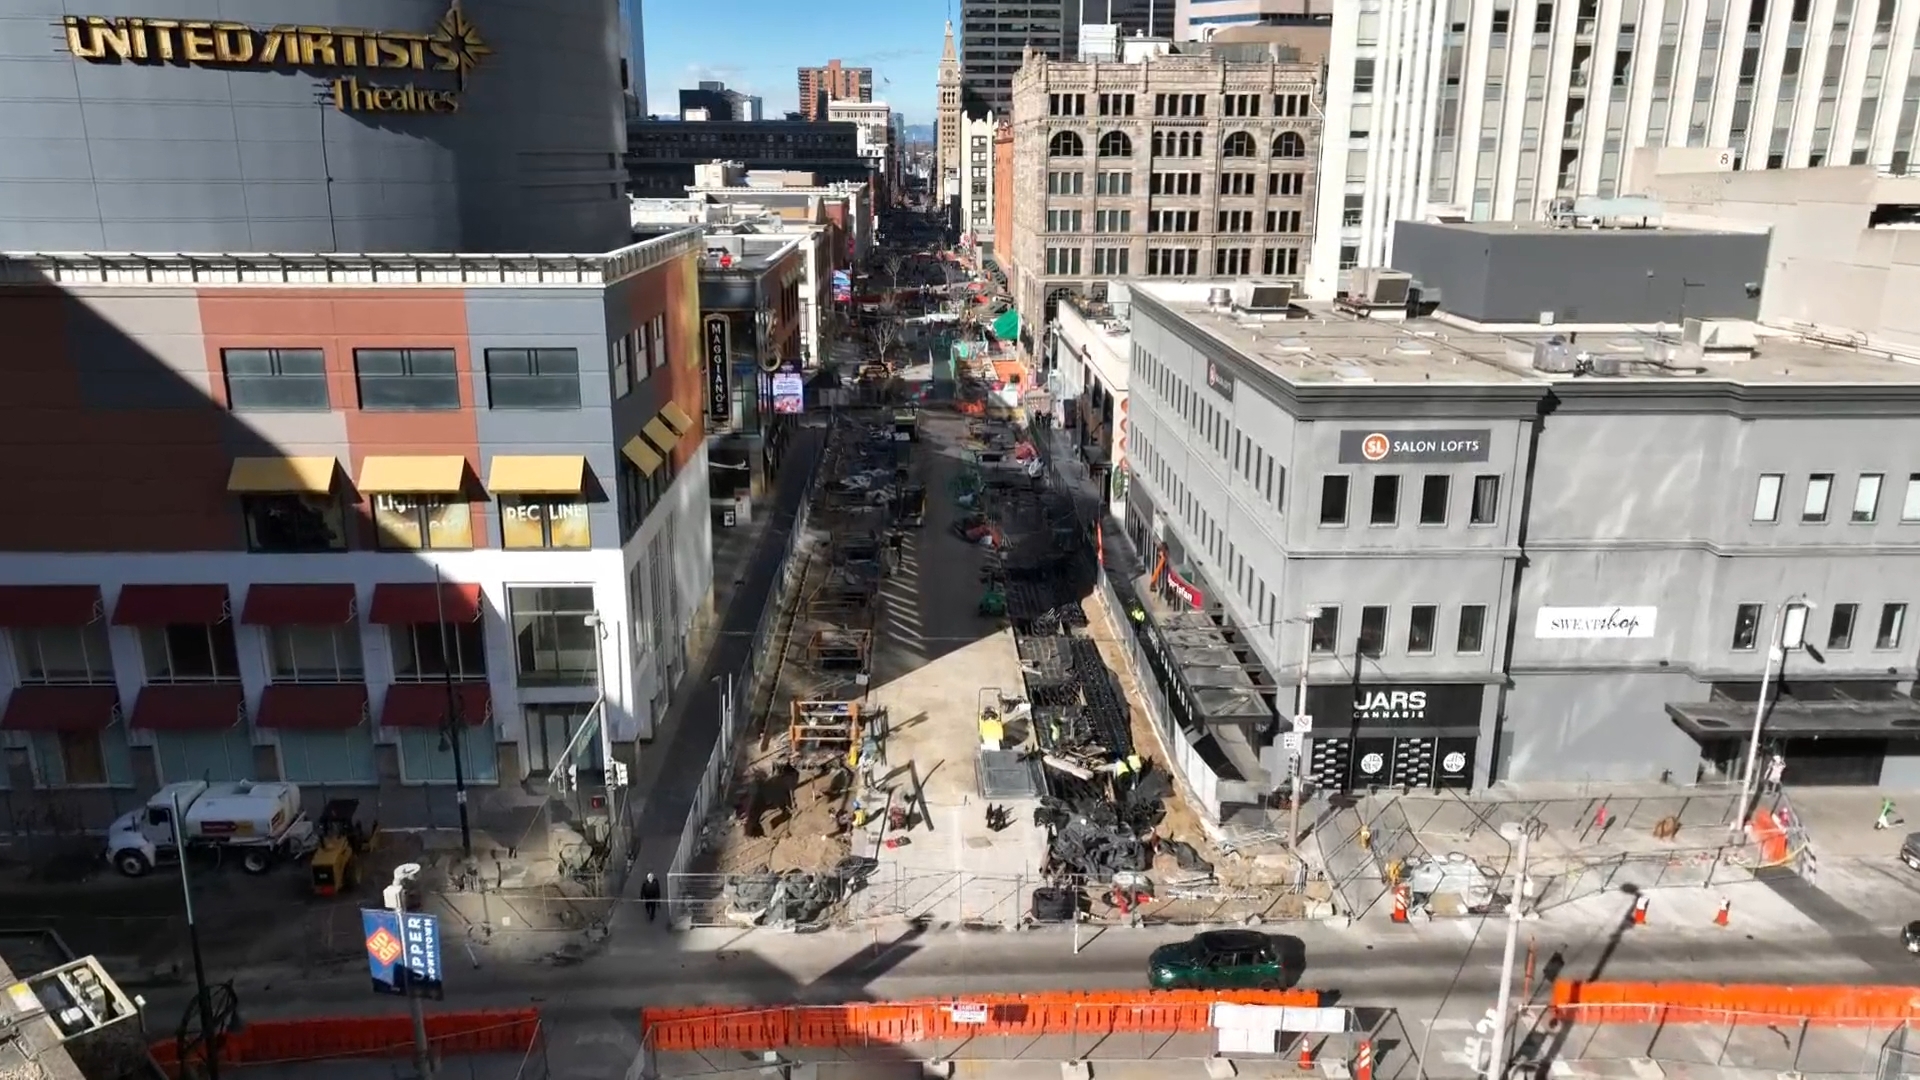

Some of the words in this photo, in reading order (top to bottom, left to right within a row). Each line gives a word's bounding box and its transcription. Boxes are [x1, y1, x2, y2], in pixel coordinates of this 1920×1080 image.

[63, 15, 252, 62] UNITED
[258, 24, 461, 70] ARTISTS
[334, 76, 460, 112] Theatres
[1720, 153, 1729, 165] 8
[711, 323, 726, 413] MAGGIANO'S
[1366, 440, 1385, 453] SL
[1393, 441, 1437, 452] SALON
[1440, 440, 1480, 452] LOFTS
[1353, 691, 1427, 711] JARS
[1353, 711, 1424, 719] CANNABIS
[408, 918, 424, 979] UPPER
